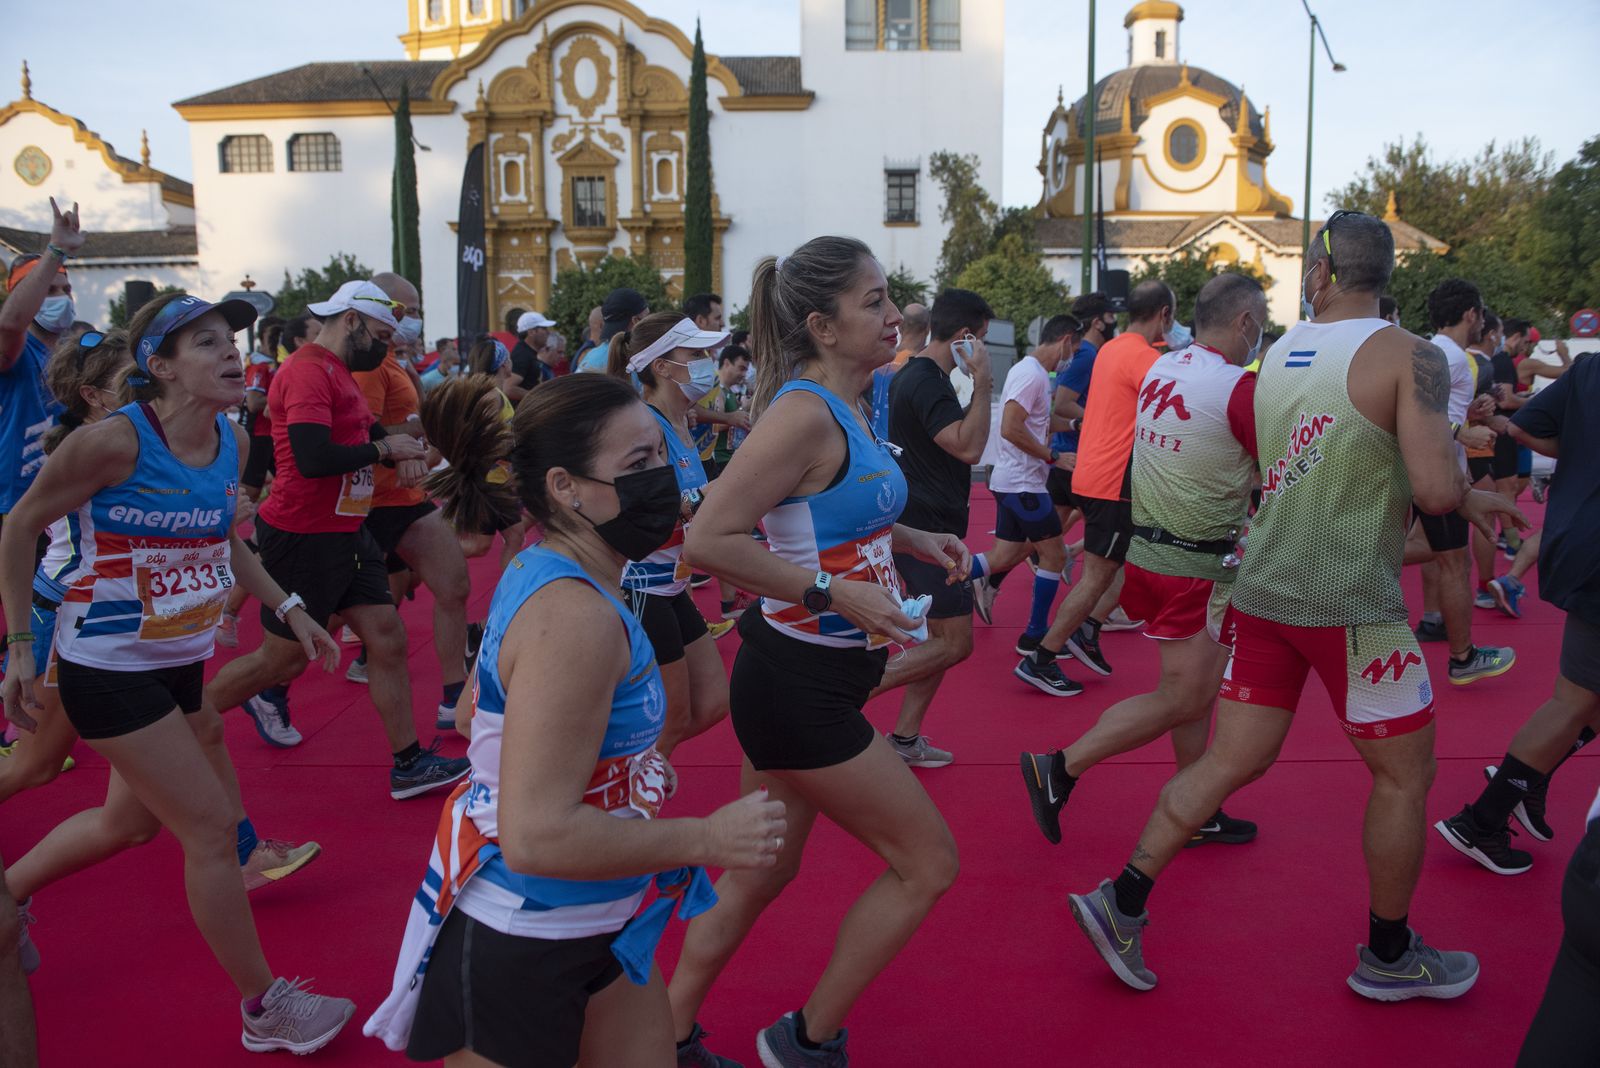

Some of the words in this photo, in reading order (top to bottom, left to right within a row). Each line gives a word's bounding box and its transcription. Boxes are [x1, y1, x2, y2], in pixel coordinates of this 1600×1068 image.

[108, 505, 223, 532] enerplus
[146, 552, 167, 565] edp
[183, 552, 200, 562] edp
[150, 563, 218, 598] 3233
